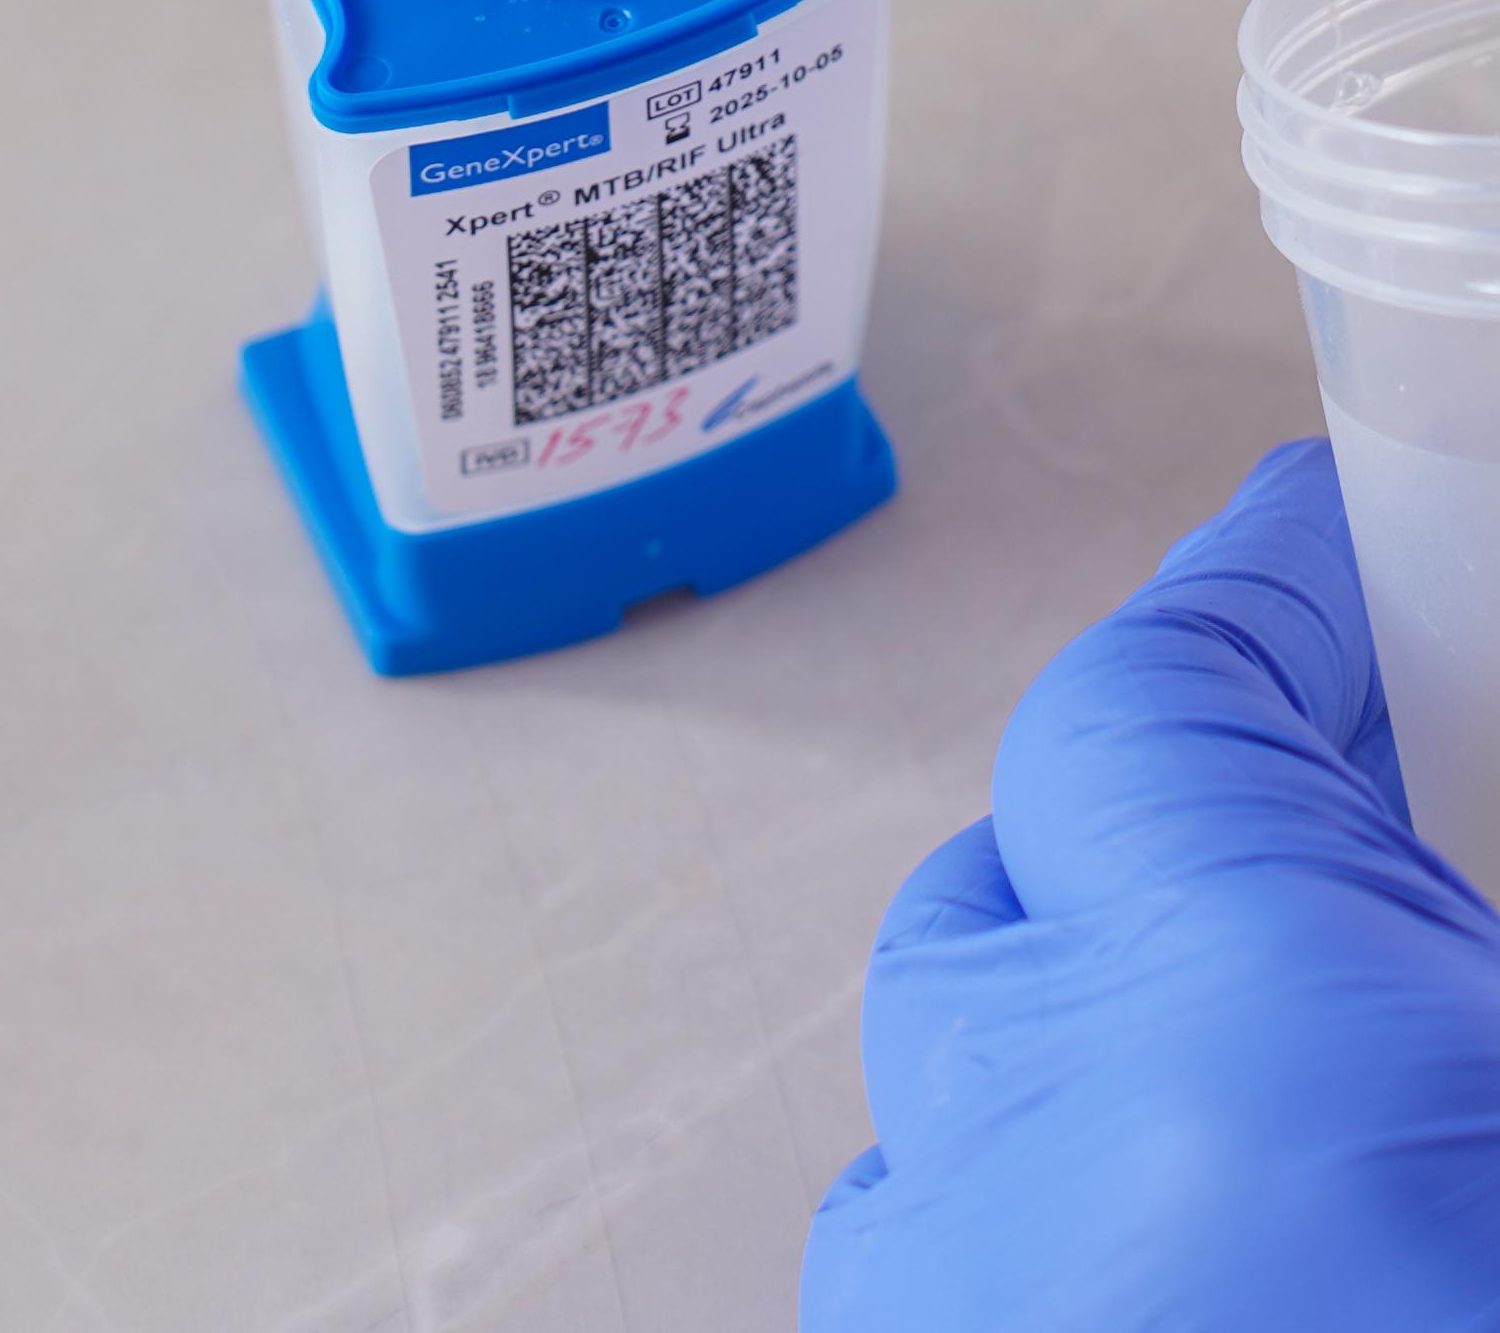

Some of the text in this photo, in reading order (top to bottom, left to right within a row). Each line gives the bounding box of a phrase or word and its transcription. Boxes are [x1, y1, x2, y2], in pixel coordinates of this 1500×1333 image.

[654, 48, 782, 113] LOT 47911
[709, 43, 844, 124] 2025-10-05
[574, 143, 706, 207] MTB/RIF
[718, 111, 787, 154] Ultra
[434, 259, 460, 302] 2541
[537, 386, 691, 469] 1573
